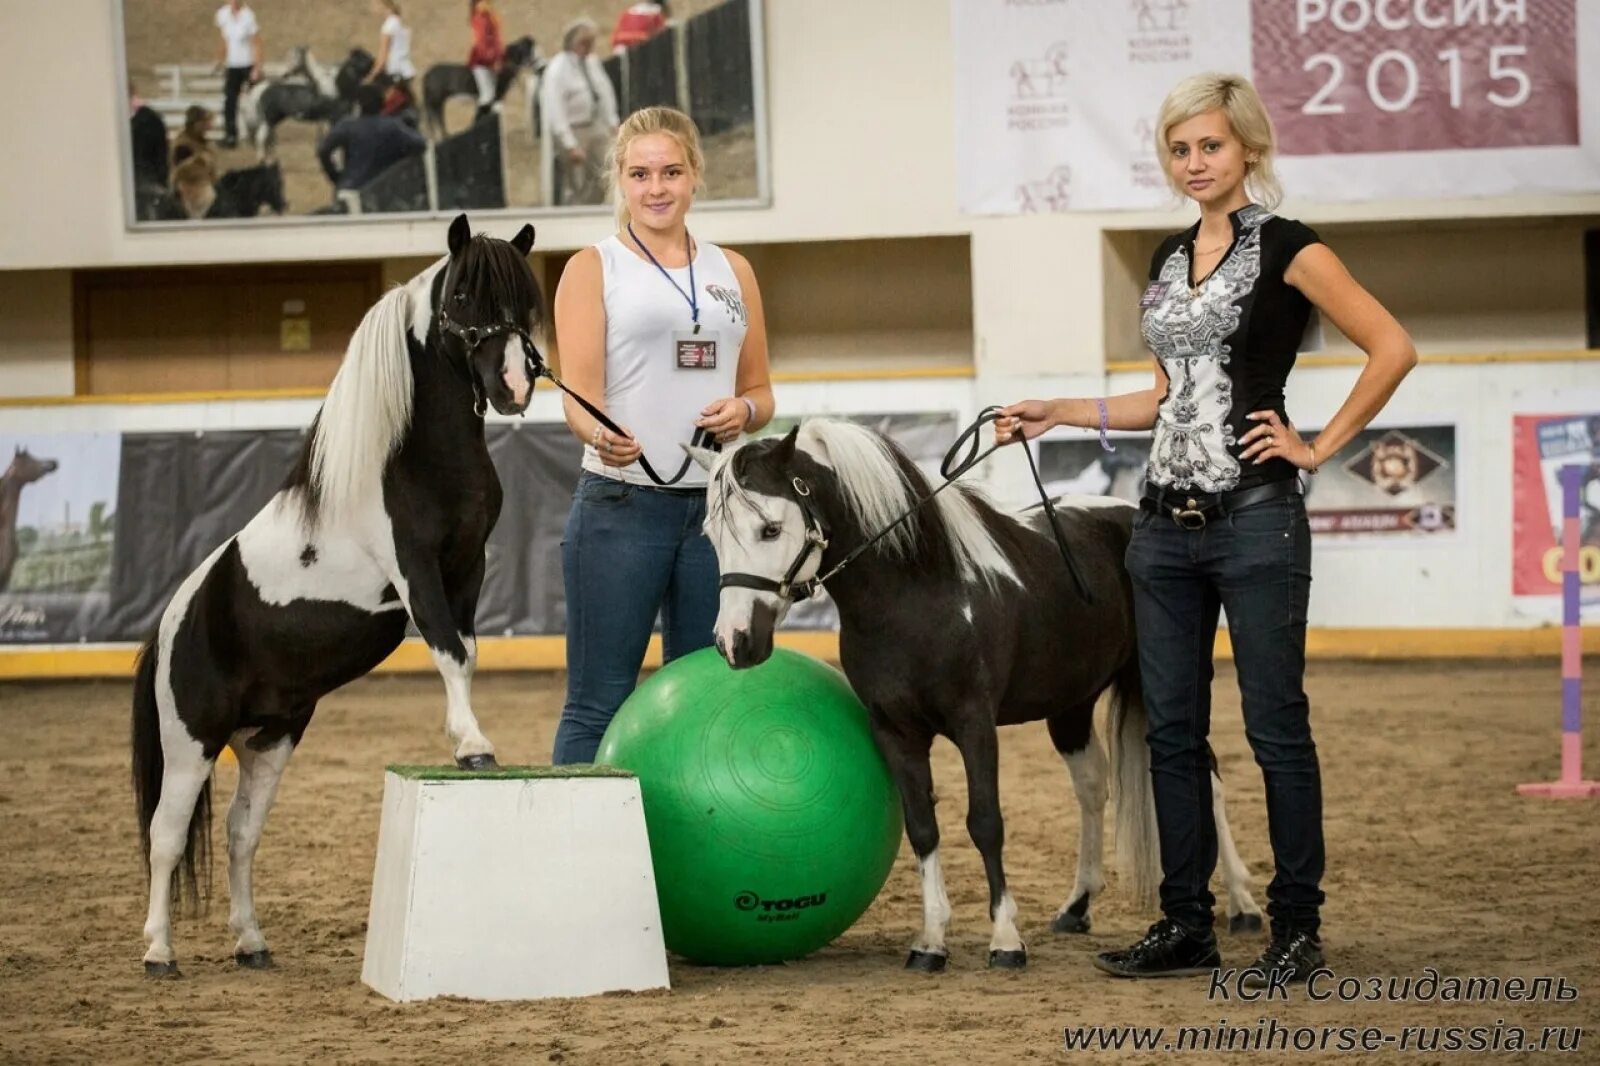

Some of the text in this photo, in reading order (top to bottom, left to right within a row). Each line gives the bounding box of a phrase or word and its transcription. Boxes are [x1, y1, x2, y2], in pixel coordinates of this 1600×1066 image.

[1297, 0, 1528, 34] РОССИЯ
[1302, 45, 1532, 115] 2015
[761, 892, 828, 911] TOGU
